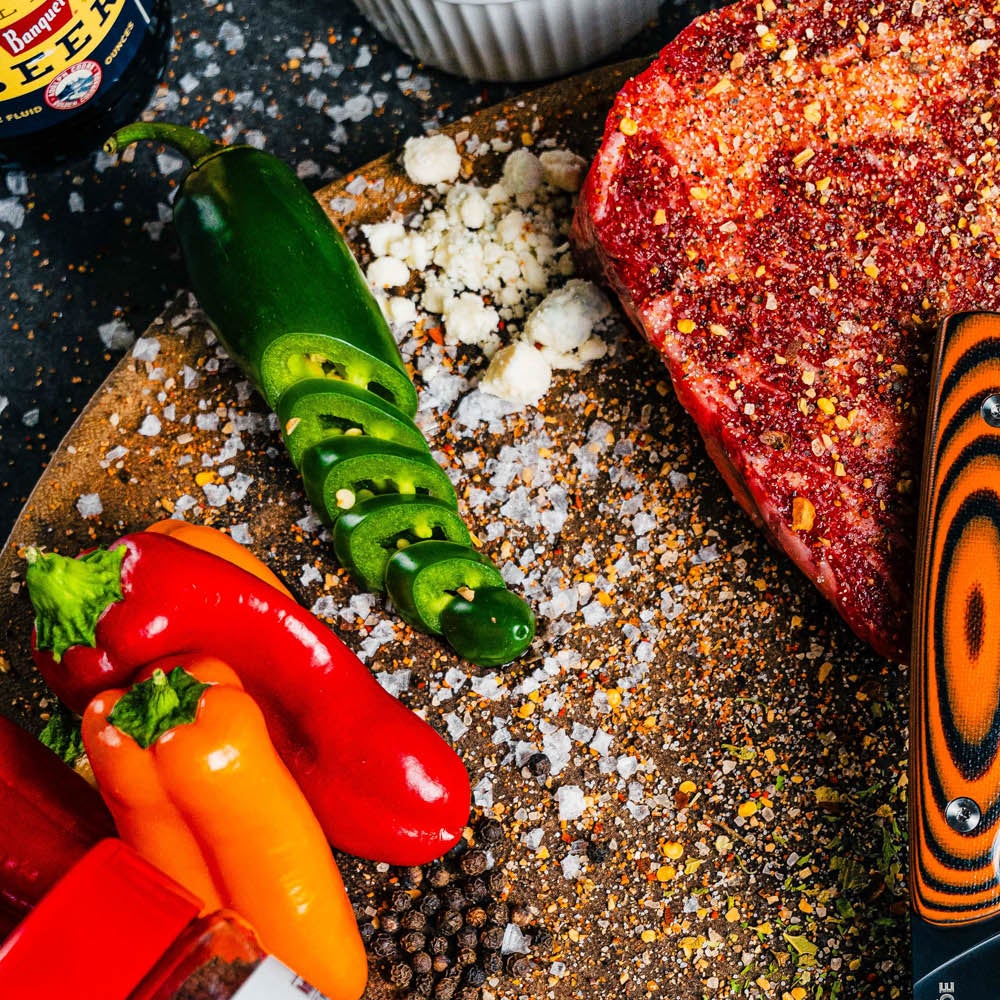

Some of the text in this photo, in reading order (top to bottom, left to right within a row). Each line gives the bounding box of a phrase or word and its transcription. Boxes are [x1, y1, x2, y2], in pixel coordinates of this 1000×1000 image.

[0, 0, 119, 93] EER
[5, 20, 135, 122] FLUID OUNCES
